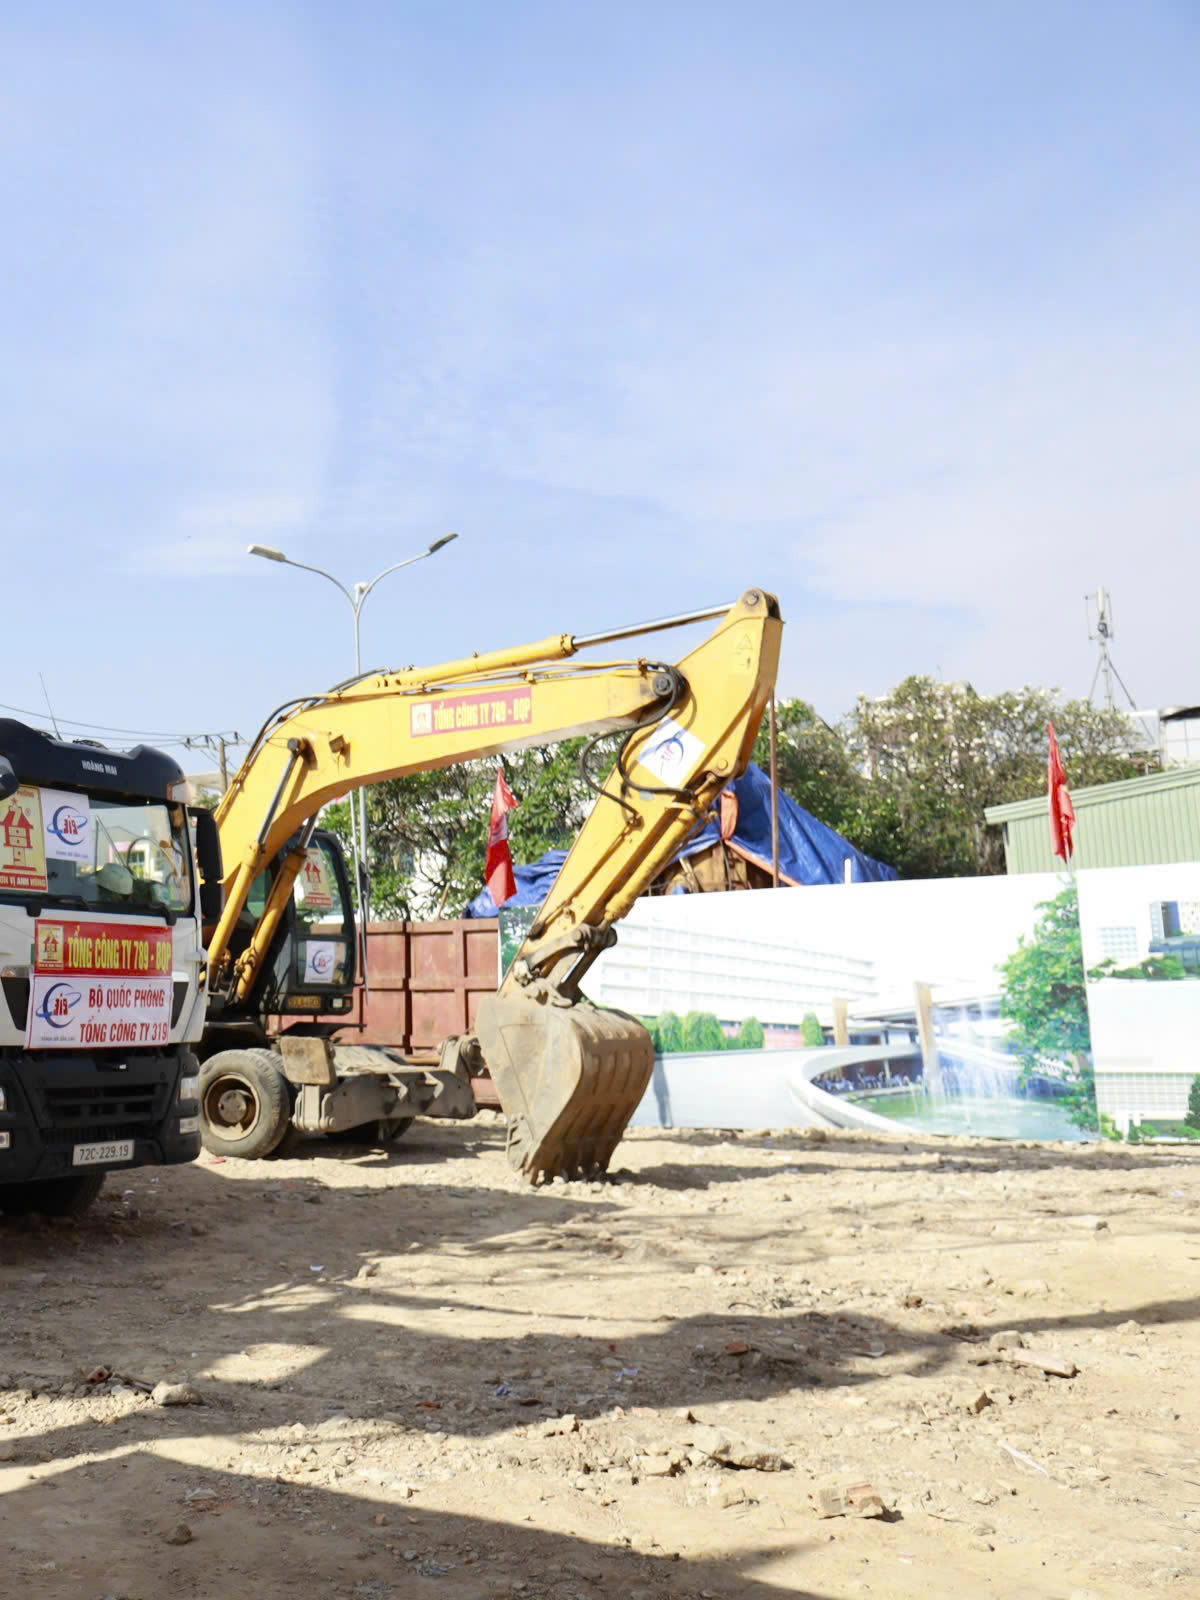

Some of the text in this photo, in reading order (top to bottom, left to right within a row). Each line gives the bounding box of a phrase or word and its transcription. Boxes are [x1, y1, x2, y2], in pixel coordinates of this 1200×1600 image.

[68, 925, 93, 969] TỔNG
[95, 932, 120, 969] CÔNG
[121, 939, 133, 970] TY
[134, 940, 149, 971] 789
[88, 982, 165, 1012] BỘ QUỐC PHÒNG
[80, 1015, 168, 1043] TỔNG CÔNG TY 319
[80, 1144, 129, 1160] 72C-229.19
